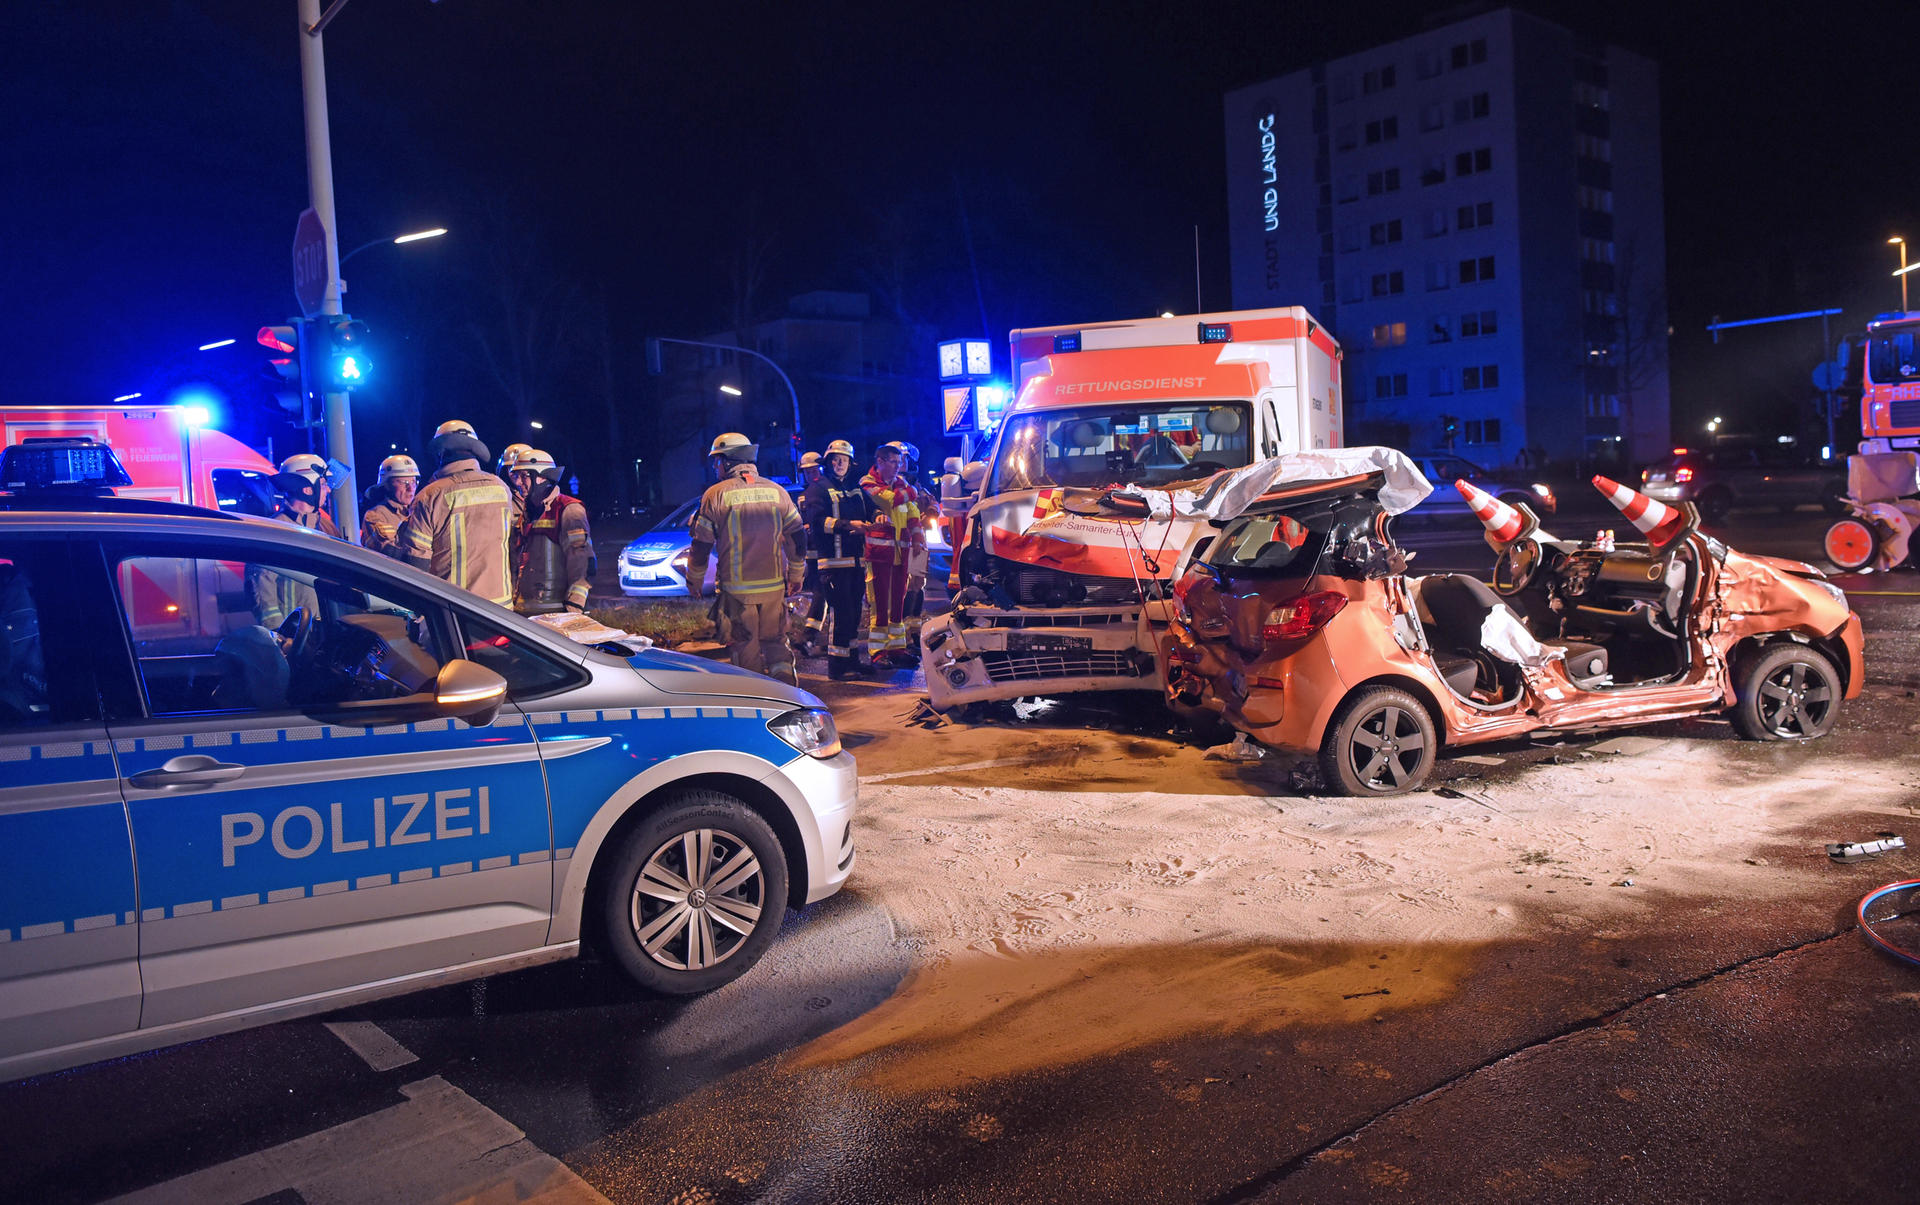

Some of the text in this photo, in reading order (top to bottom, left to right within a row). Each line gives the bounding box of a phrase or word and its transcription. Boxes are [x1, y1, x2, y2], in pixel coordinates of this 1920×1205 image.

[1264, 188, 1279, 232] UND
[296, 240, 323, 288] STOP
[1055, 377, 1206, 395] RETTUNGSDIENST
[130, 454, 178, 463] FEUERWEHR
[221, 786, 490, 867] POLIZEI
